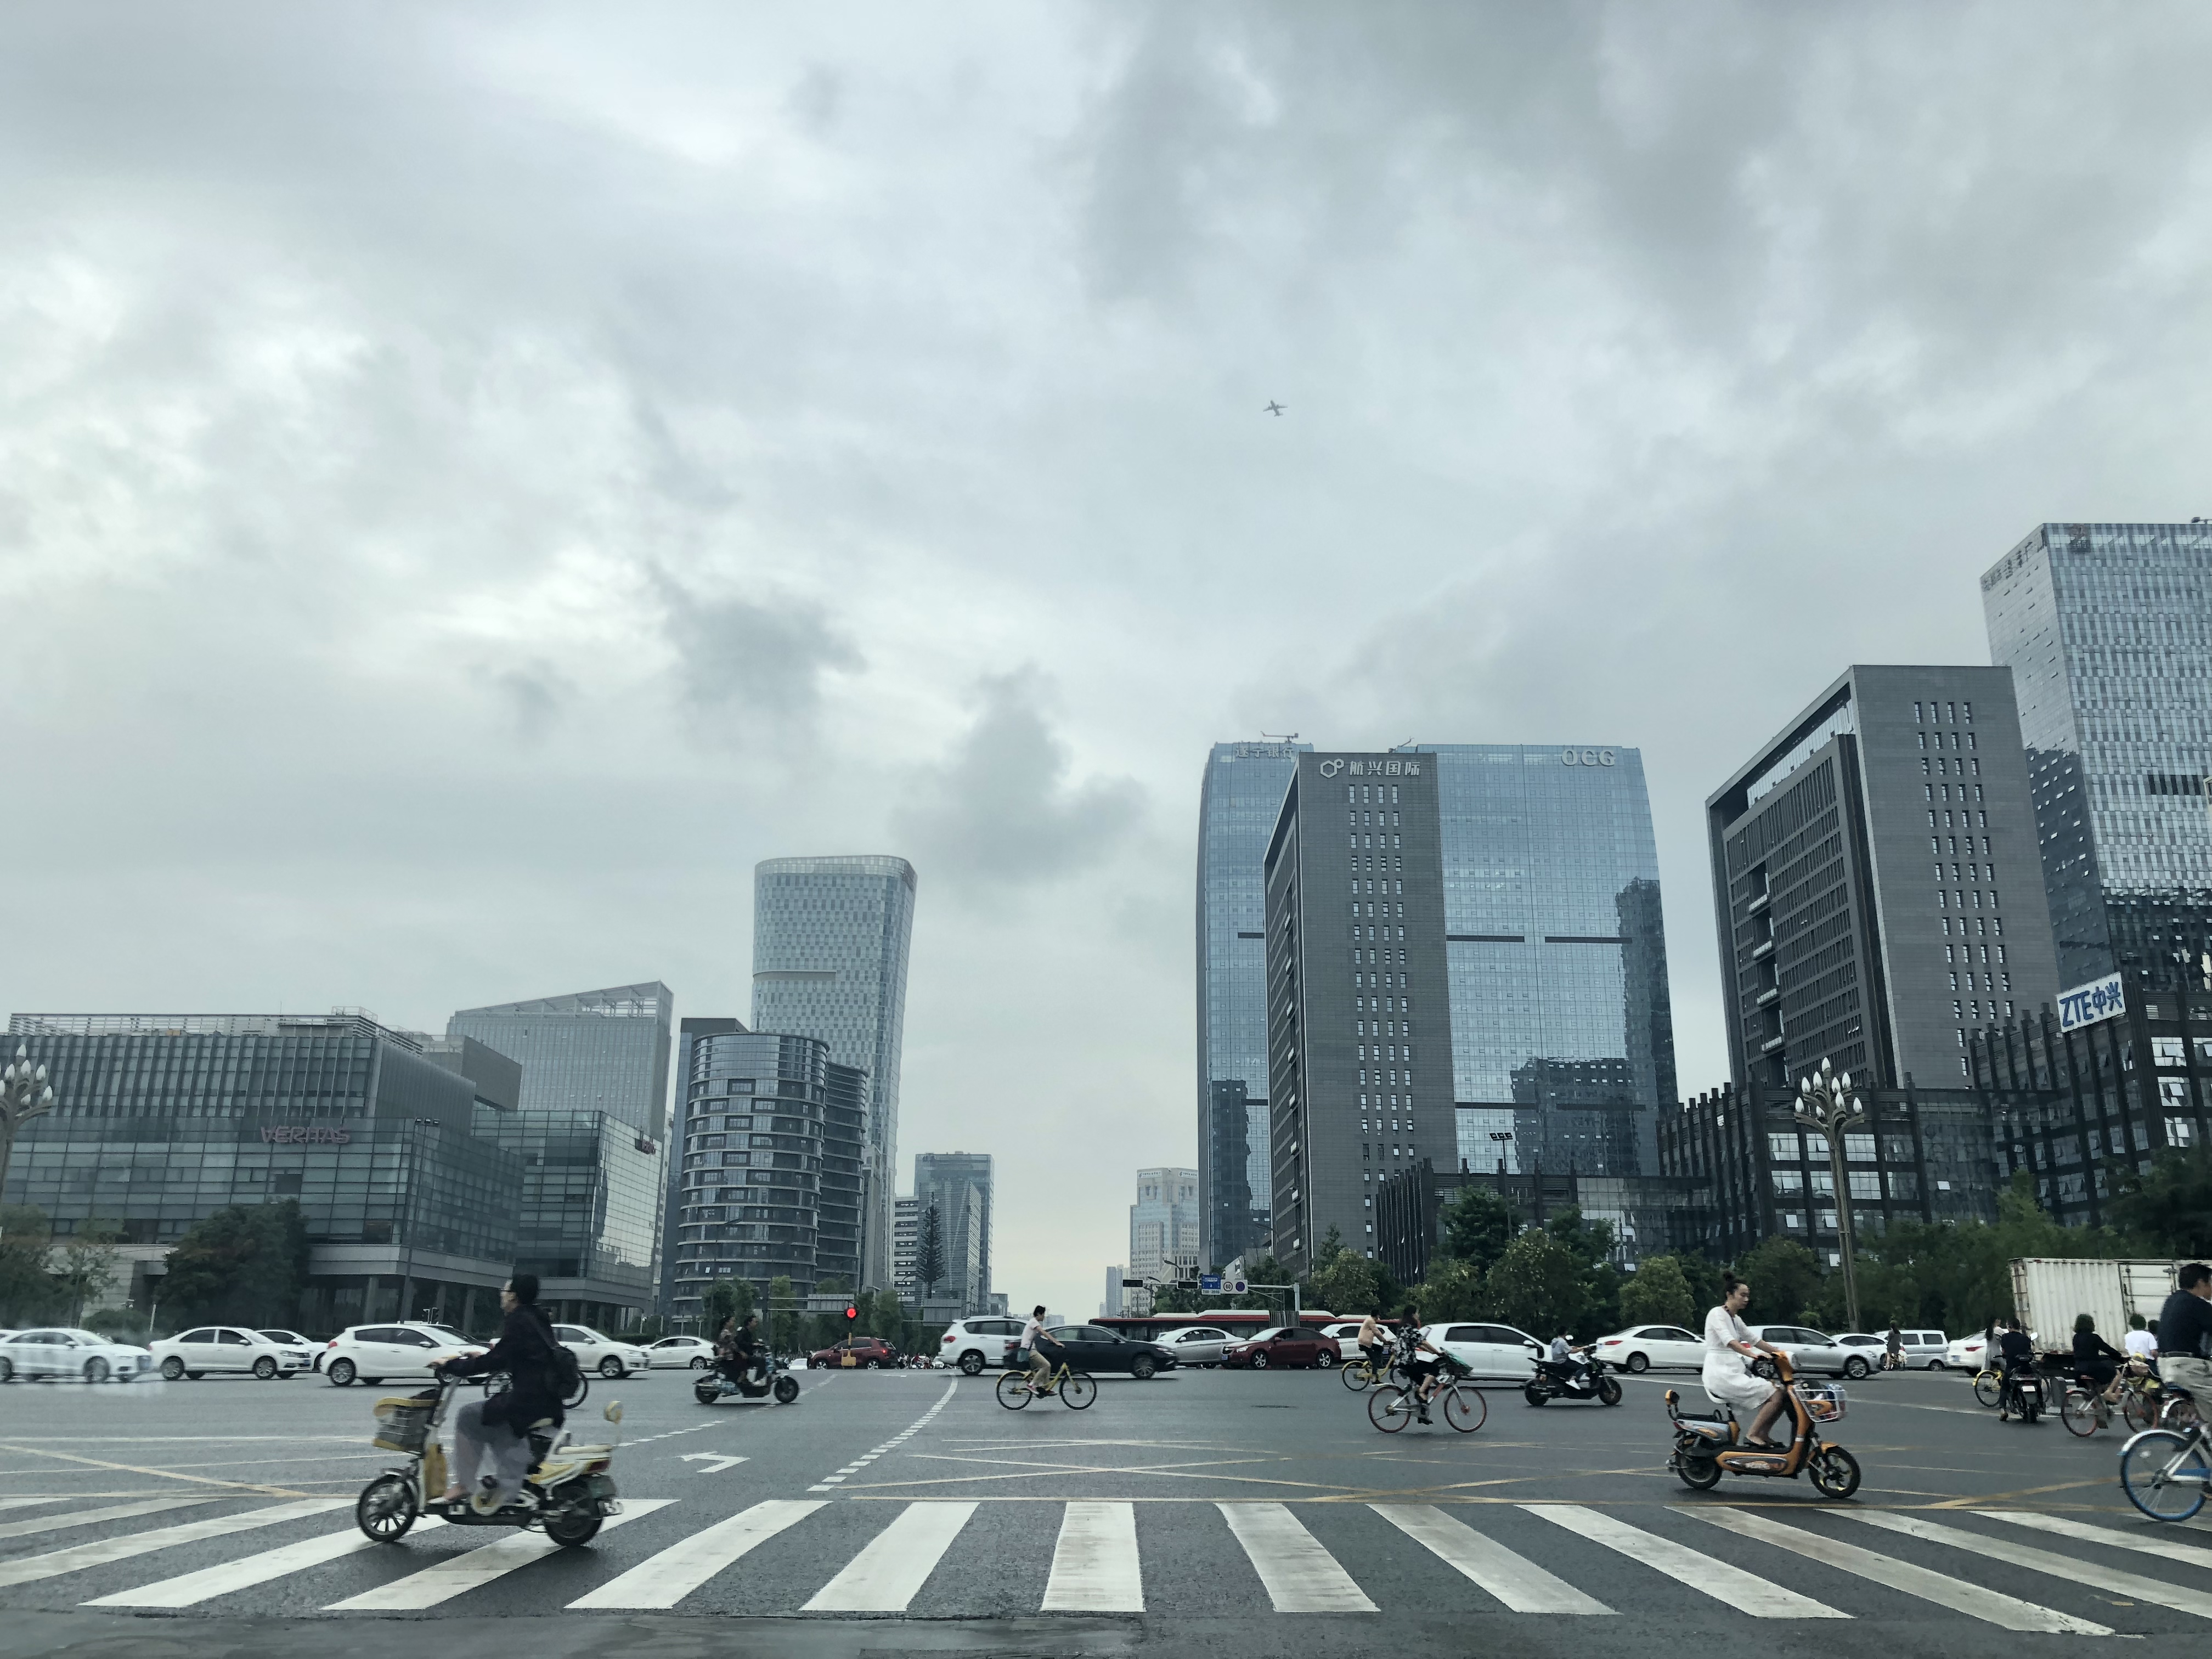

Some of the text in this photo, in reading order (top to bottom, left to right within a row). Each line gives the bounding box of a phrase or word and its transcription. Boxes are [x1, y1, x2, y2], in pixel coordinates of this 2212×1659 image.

[1235, 746, 1294, 758] 遂宁银行
[1561, 749, 1616, 766] OCG
[1349, 760, 1420, 776] 航兴国际
[260, 1126, 351, 1144] VERITAS
